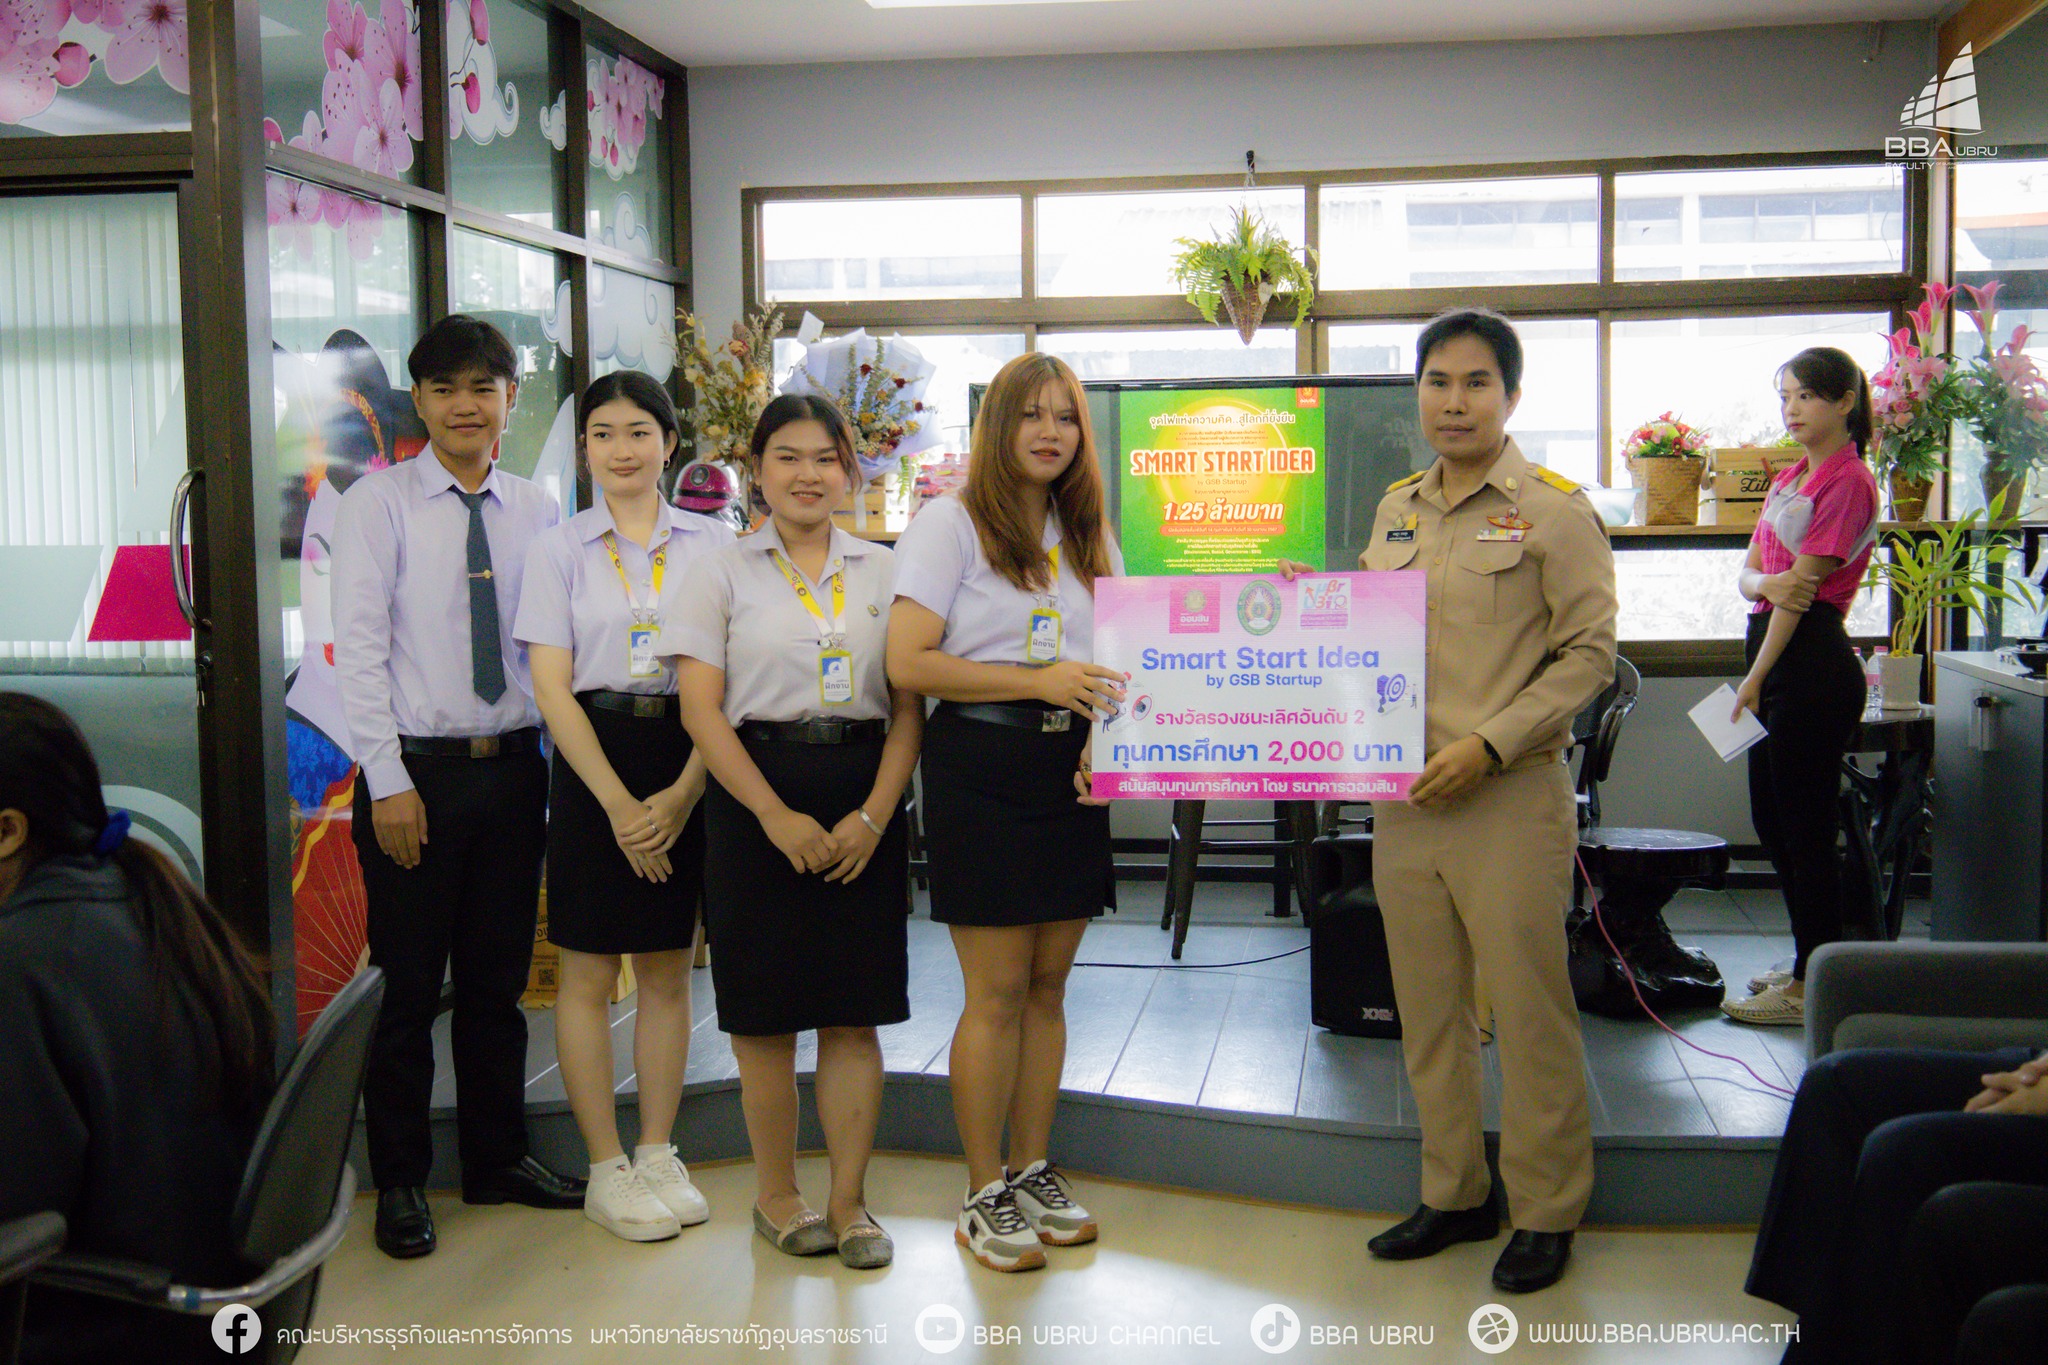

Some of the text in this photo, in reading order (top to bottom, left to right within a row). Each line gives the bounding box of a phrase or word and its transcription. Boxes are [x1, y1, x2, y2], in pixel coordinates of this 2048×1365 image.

[1131, 448, 1315, 475] SMART START IDEA
[1222, 478, 1248, 487] Startup
[1163, 498, 1285, 522] 1.25 ล้านบาท
[1141, 646, 1380, 670] Smart Start Idea
[1206, 673, 1323, 687] by GSB Startup
[1155, 709, 1365, 726] รางวัลรองชนะเลิศอันดับ 2
[1113, 738, 1403, 769] ทุนการศึกษา 2,000 บาท
[1263, 778, 1287, 793] โดย
[1292, 776, 1398, 794] ธนาคารออมสิน
